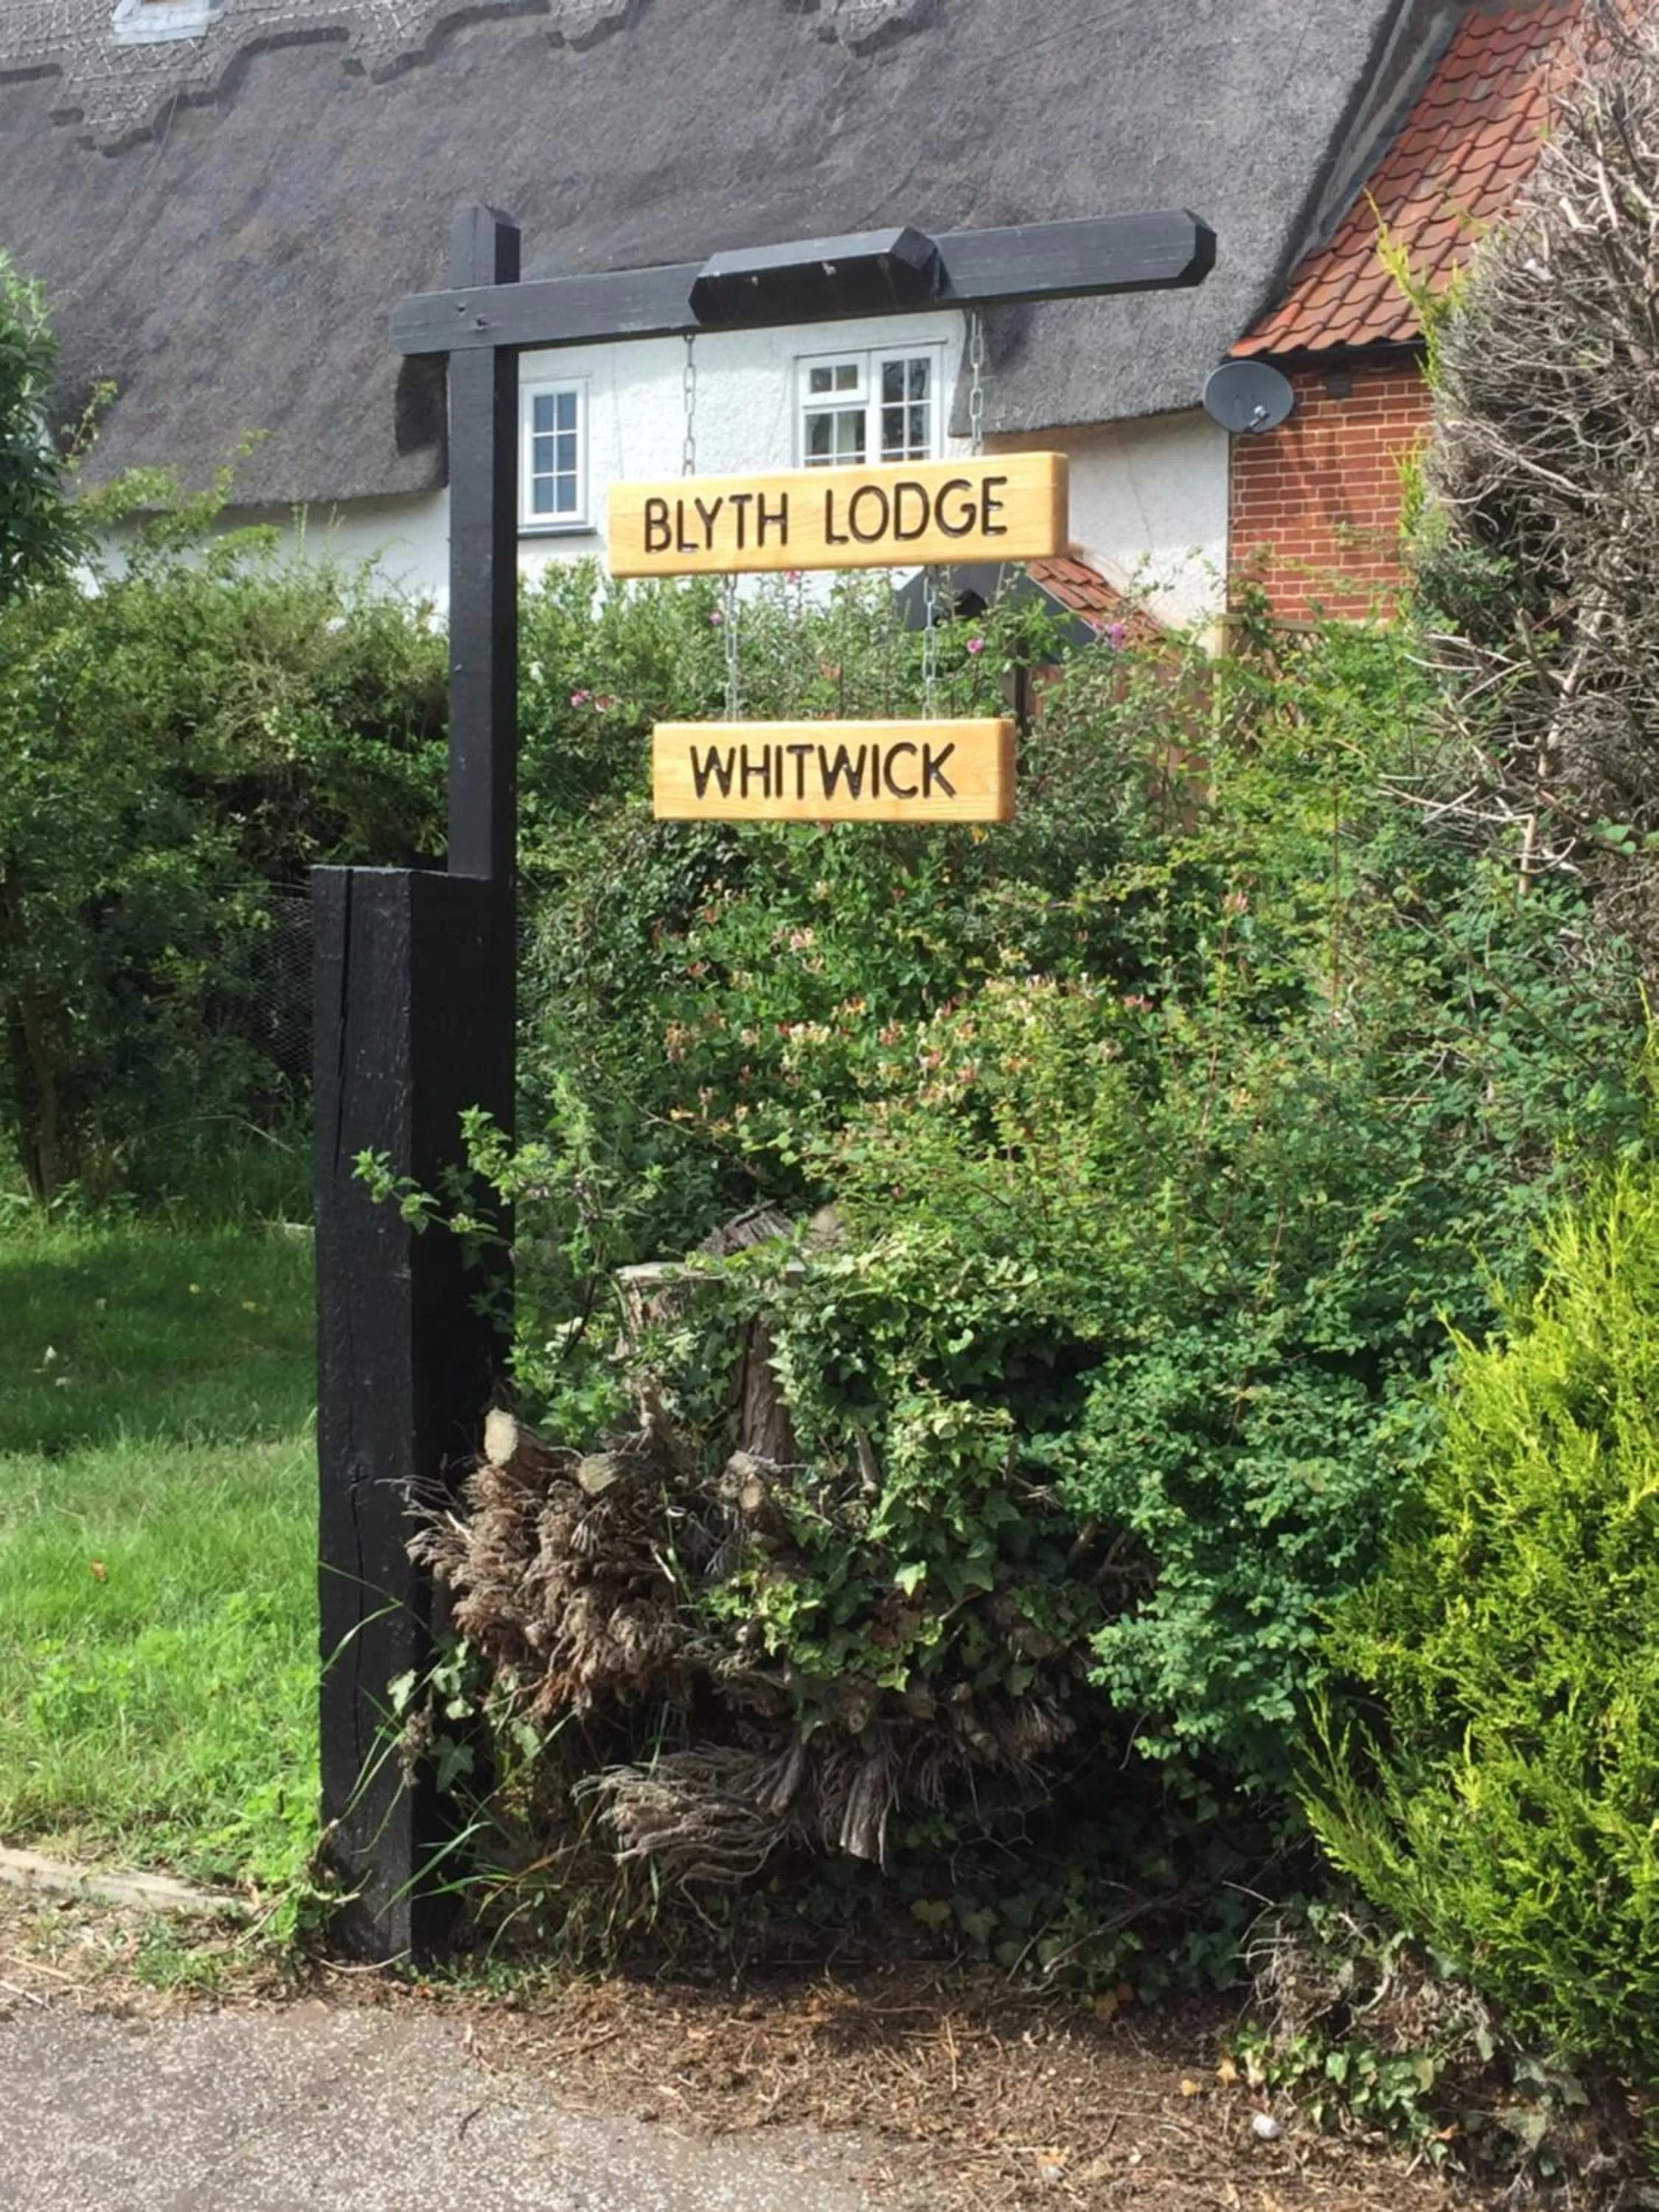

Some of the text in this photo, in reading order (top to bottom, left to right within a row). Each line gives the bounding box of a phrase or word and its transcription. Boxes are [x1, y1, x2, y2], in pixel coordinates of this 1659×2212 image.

[644, 476, 1008, 554] BLYTH LODGE
[689, 742, 956, 799] WHITWICK
